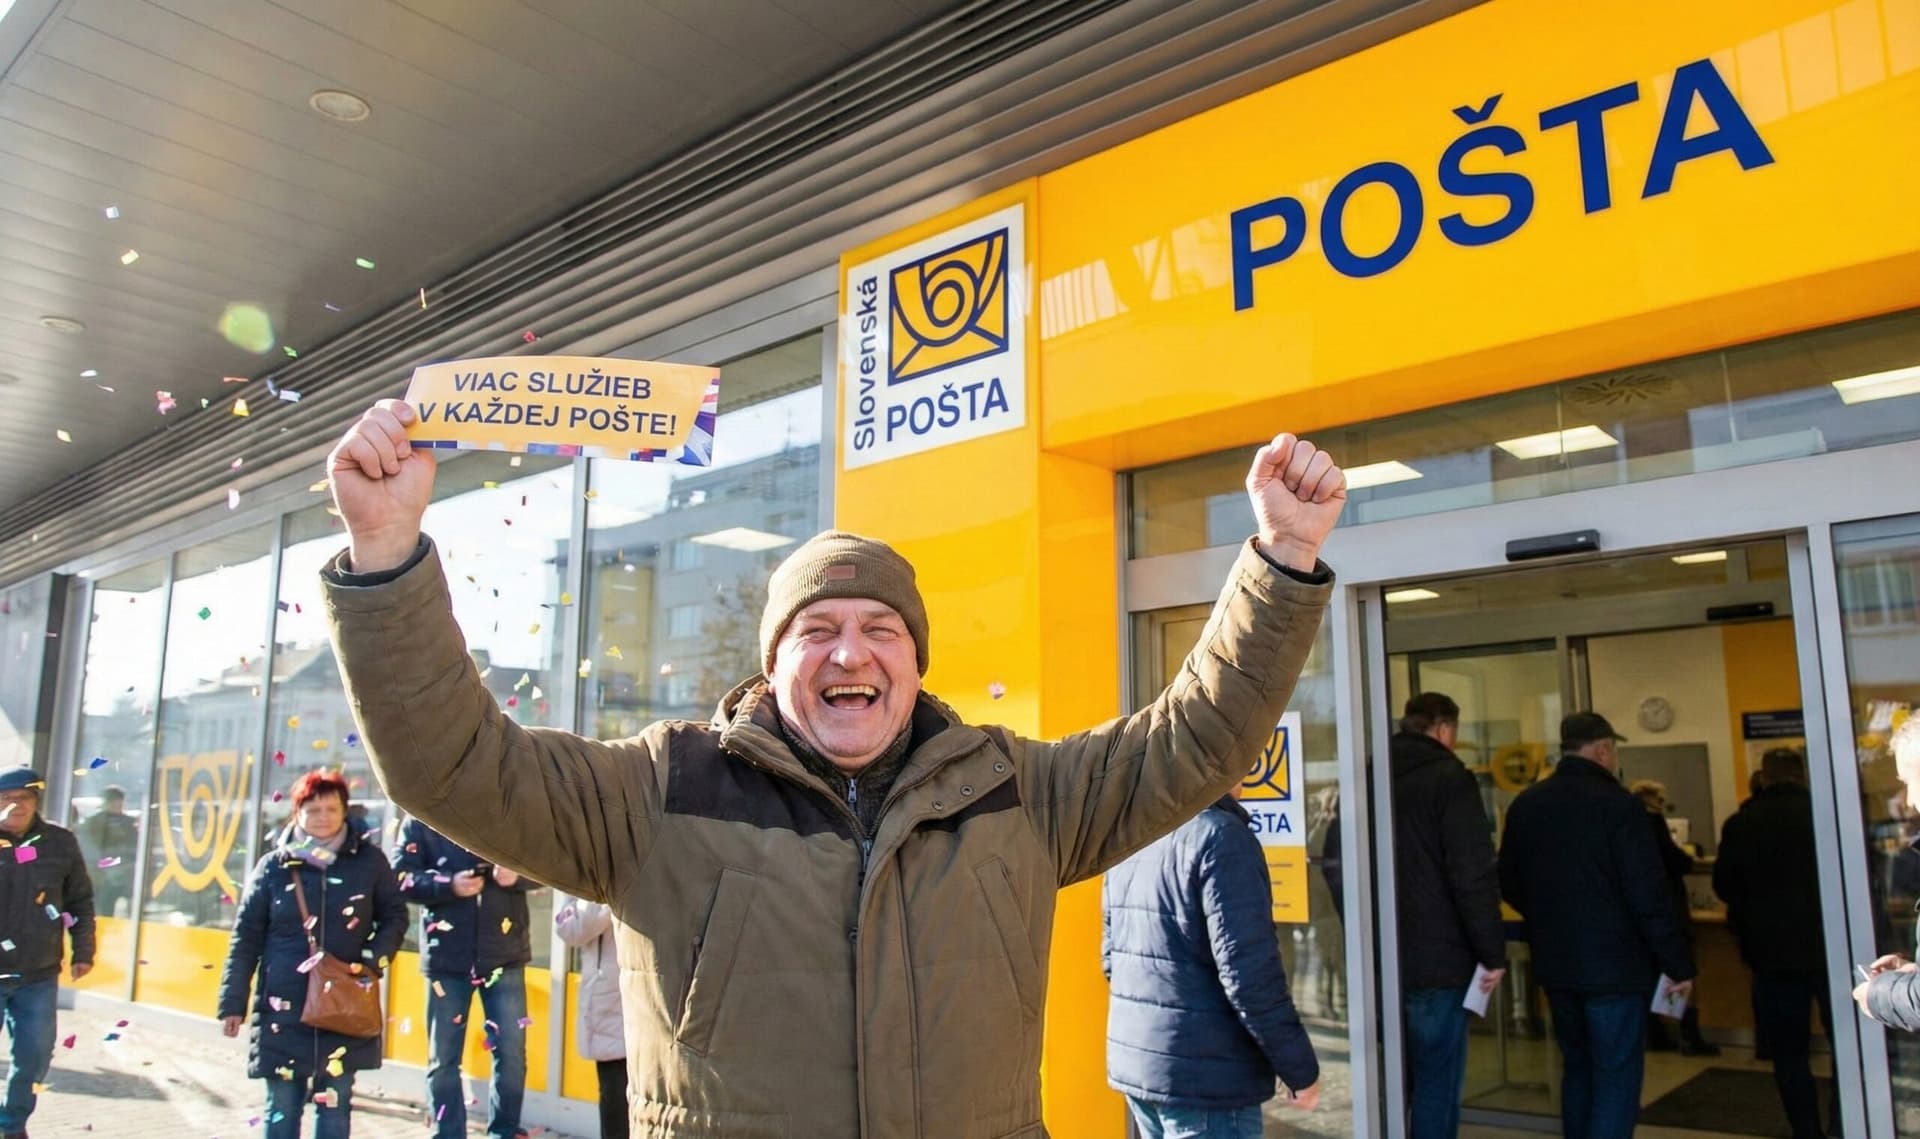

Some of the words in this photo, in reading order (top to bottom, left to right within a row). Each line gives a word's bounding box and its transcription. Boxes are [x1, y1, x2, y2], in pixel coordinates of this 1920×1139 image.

[1230, 58, 1775, 312] POŠTA
[454, 371, 518, 392] VIAC
[527, 368, 651, 399] SLUŽIEB
[854, 276, 878, 450] Slovenská
[418, 402, 436, 423] V
[444, 397, 560, 427] KAŽDEJ
[569, 405, 676, 436] POŠTE!
[887, 377, 1009, 442] POŠTA
[1249, 809, 1292, 833] ŠTA
